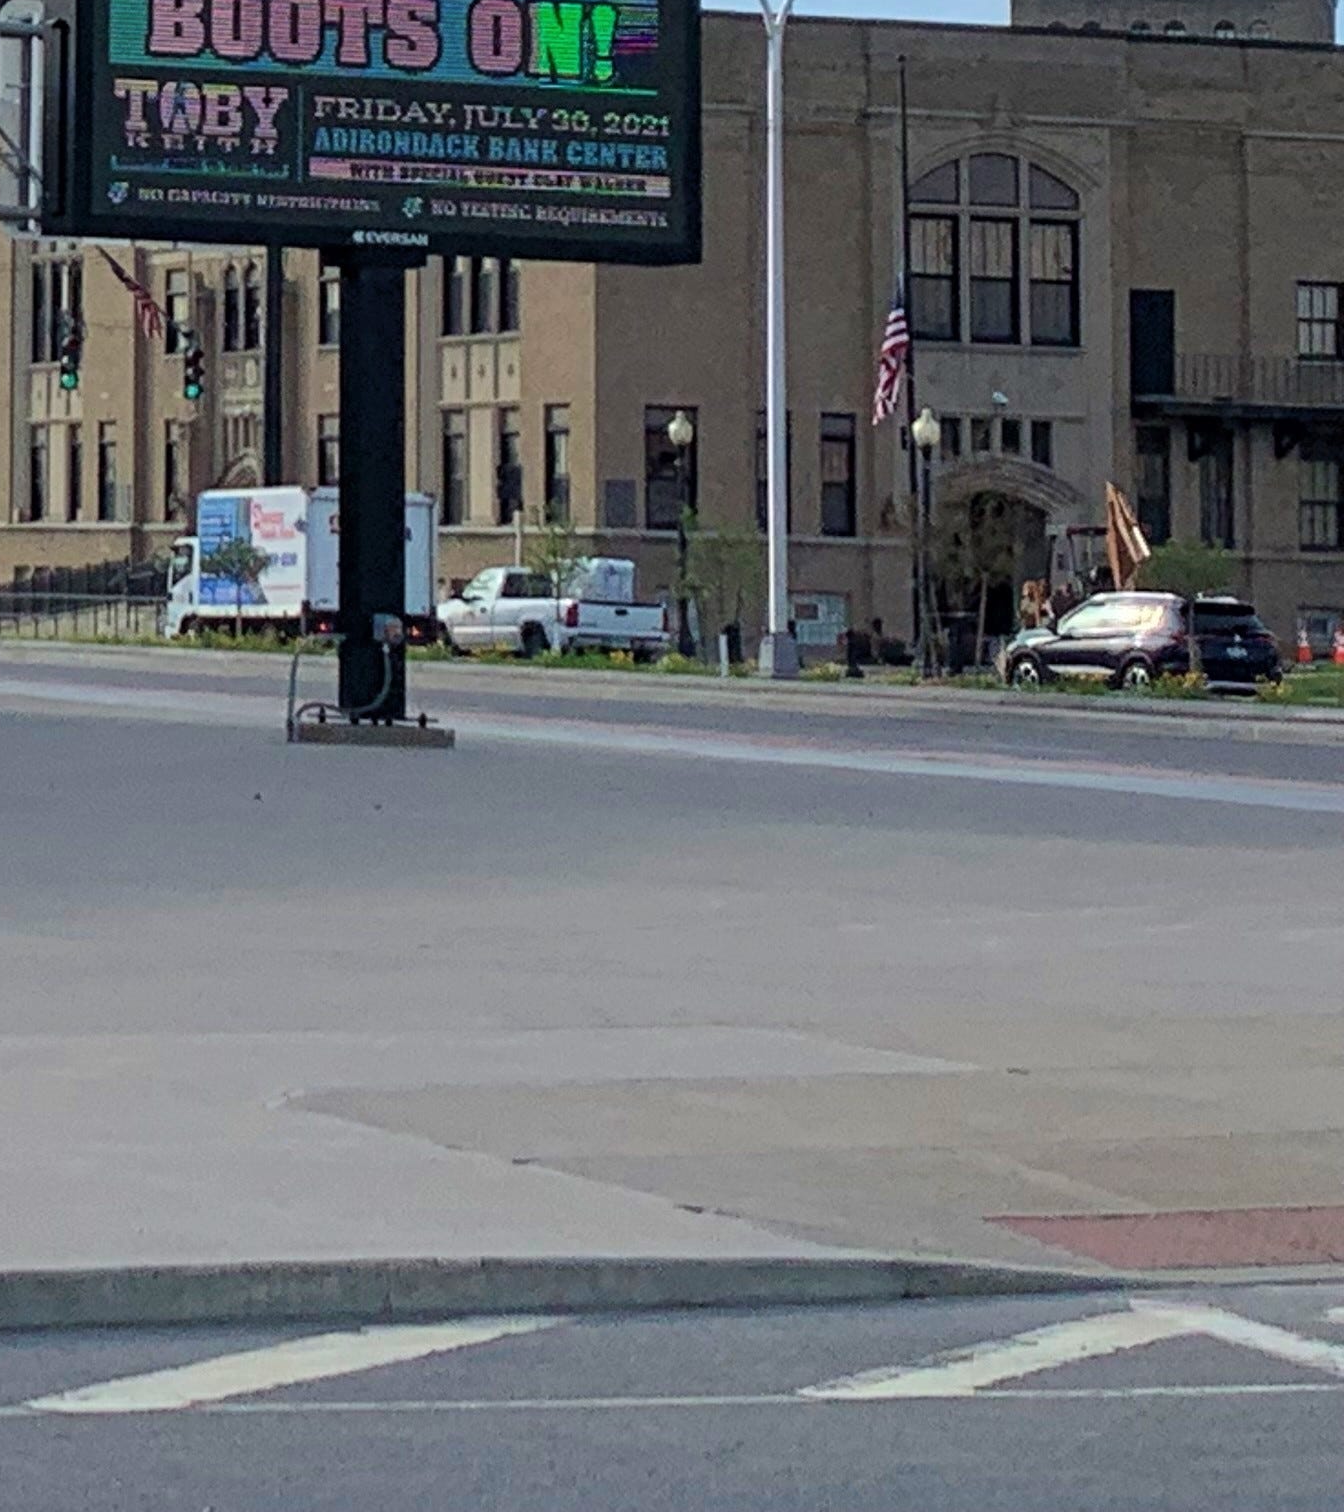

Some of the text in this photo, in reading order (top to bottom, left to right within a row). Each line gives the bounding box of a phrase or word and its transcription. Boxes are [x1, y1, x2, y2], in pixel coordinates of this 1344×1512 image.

[113, 78, 289, 138] TOBY
[314, 95, 670, 137] FRIDAY, JULY 30, 2021
[314, 126, 668, 171] ADIRONDACK BANK CENTER
